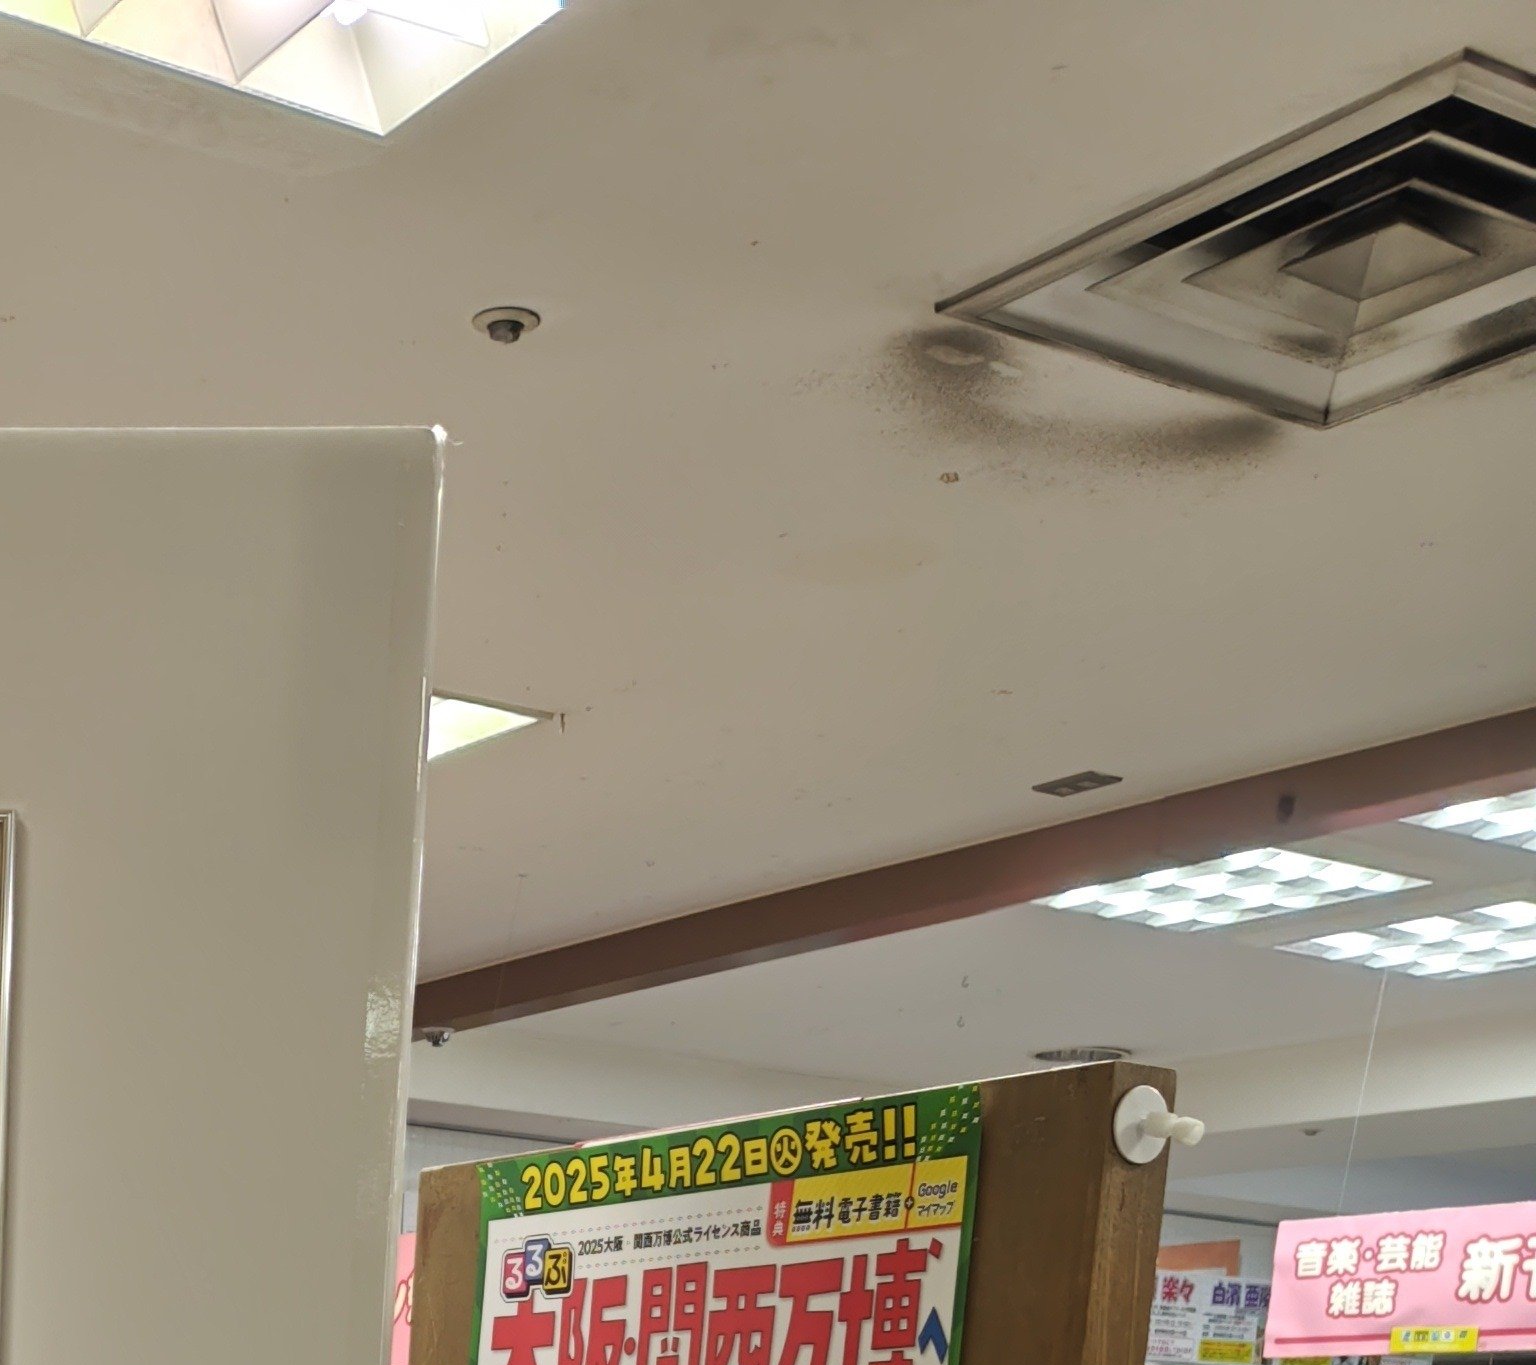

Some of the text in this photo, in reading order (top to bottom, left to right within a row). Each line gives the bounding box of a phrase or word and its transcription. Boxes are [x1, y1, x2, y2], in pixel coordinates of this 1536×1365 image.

[917, 1179, 959, 1199] Google
[792, 1192, 902, 1230] 無料電子書籍
[916, 1202, 955, 1218] マイマップ
[504, 1240, 571, 1296] るるぶ
[1295, 1229, 1447, 1281] 音楽・芸能
[1326, 1278, 1400, 1320] 雑誌
